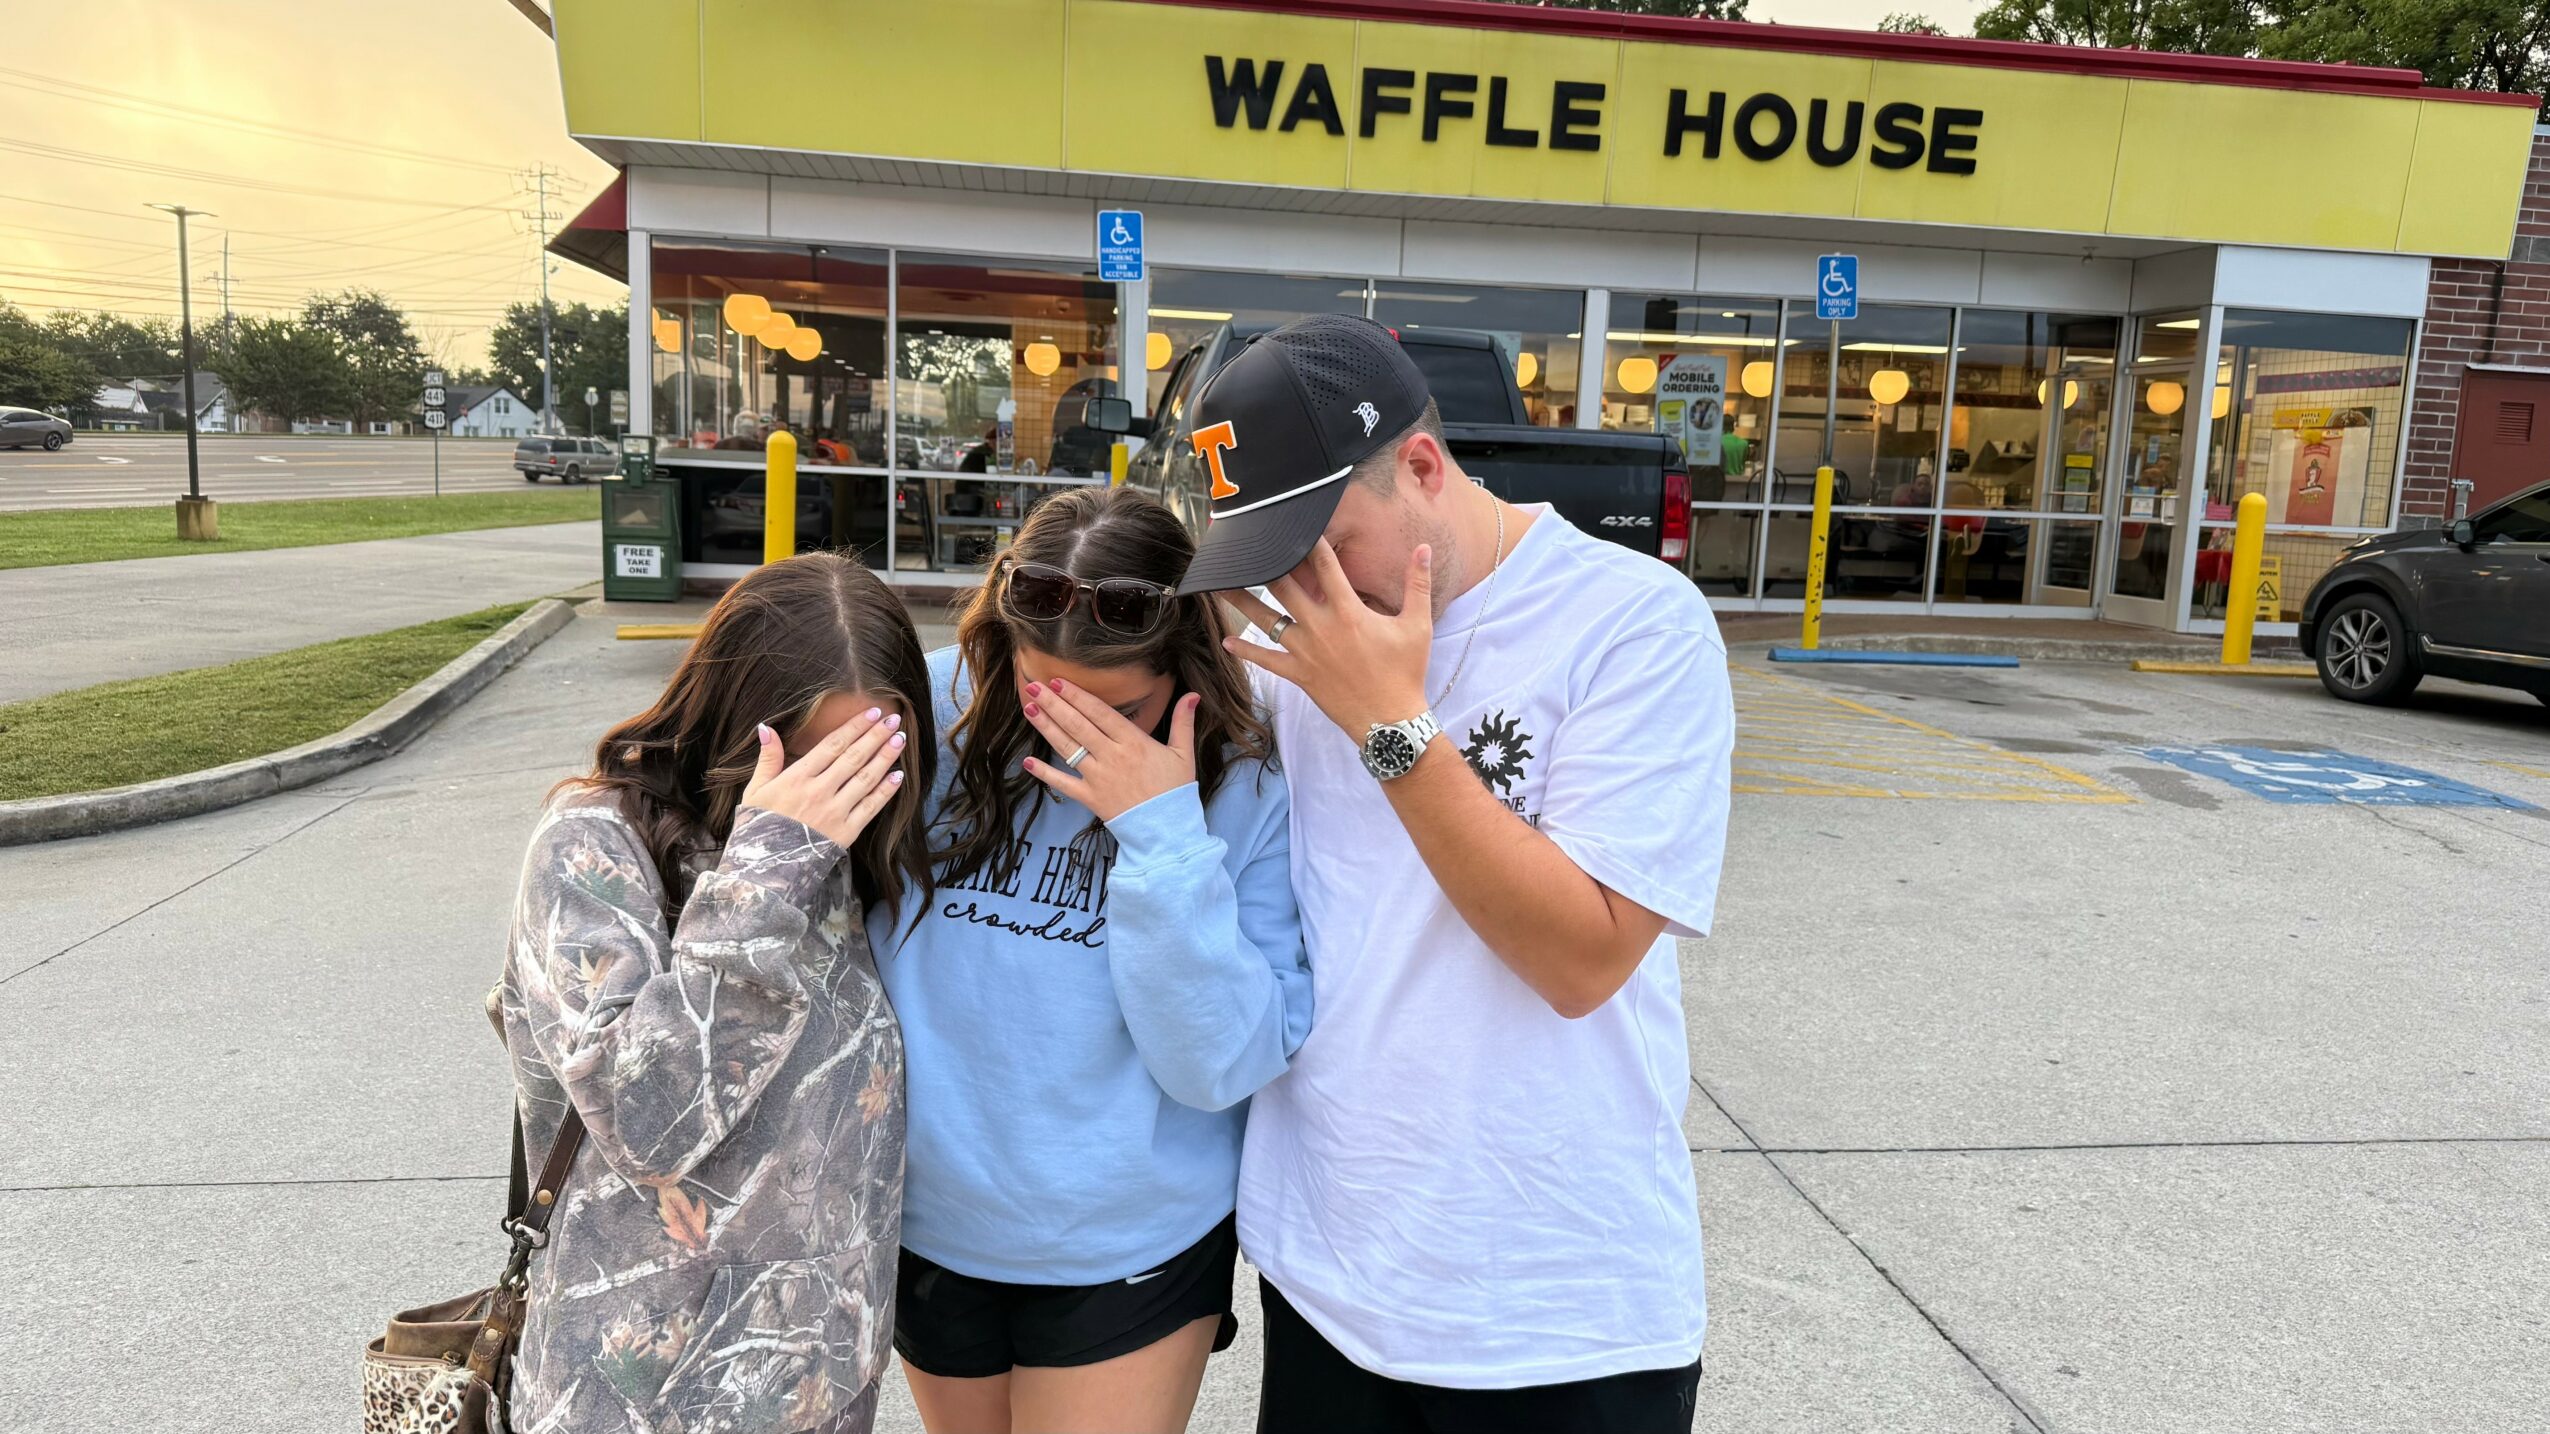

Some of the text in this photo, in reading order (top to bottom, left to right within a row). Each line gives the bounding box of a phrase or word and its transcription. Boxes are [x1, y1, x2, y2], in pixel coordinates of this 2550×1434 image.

[1204, 55, 1984, 175] WAFFLE HOUSE
[1822, 298, 1852, 307] PARKING
[1827, 307, 1846, 316] ONLY
[1669, 372, 1715, 384] MOBILE
[1662, 384, 1720, 395] ORDERING
[426, 391, 443, 402] 441
[428, 413, 443, 425] 411
[1192, 420, 1240, 500] T
[623, 547, 654, 557] FREE
[626, 558, 651, 566] TAKE
[628, 567, 649, 575] ONE
[1030, 846, 1112, 917] HEAV
[943, 901, 1106, 948] crowded
